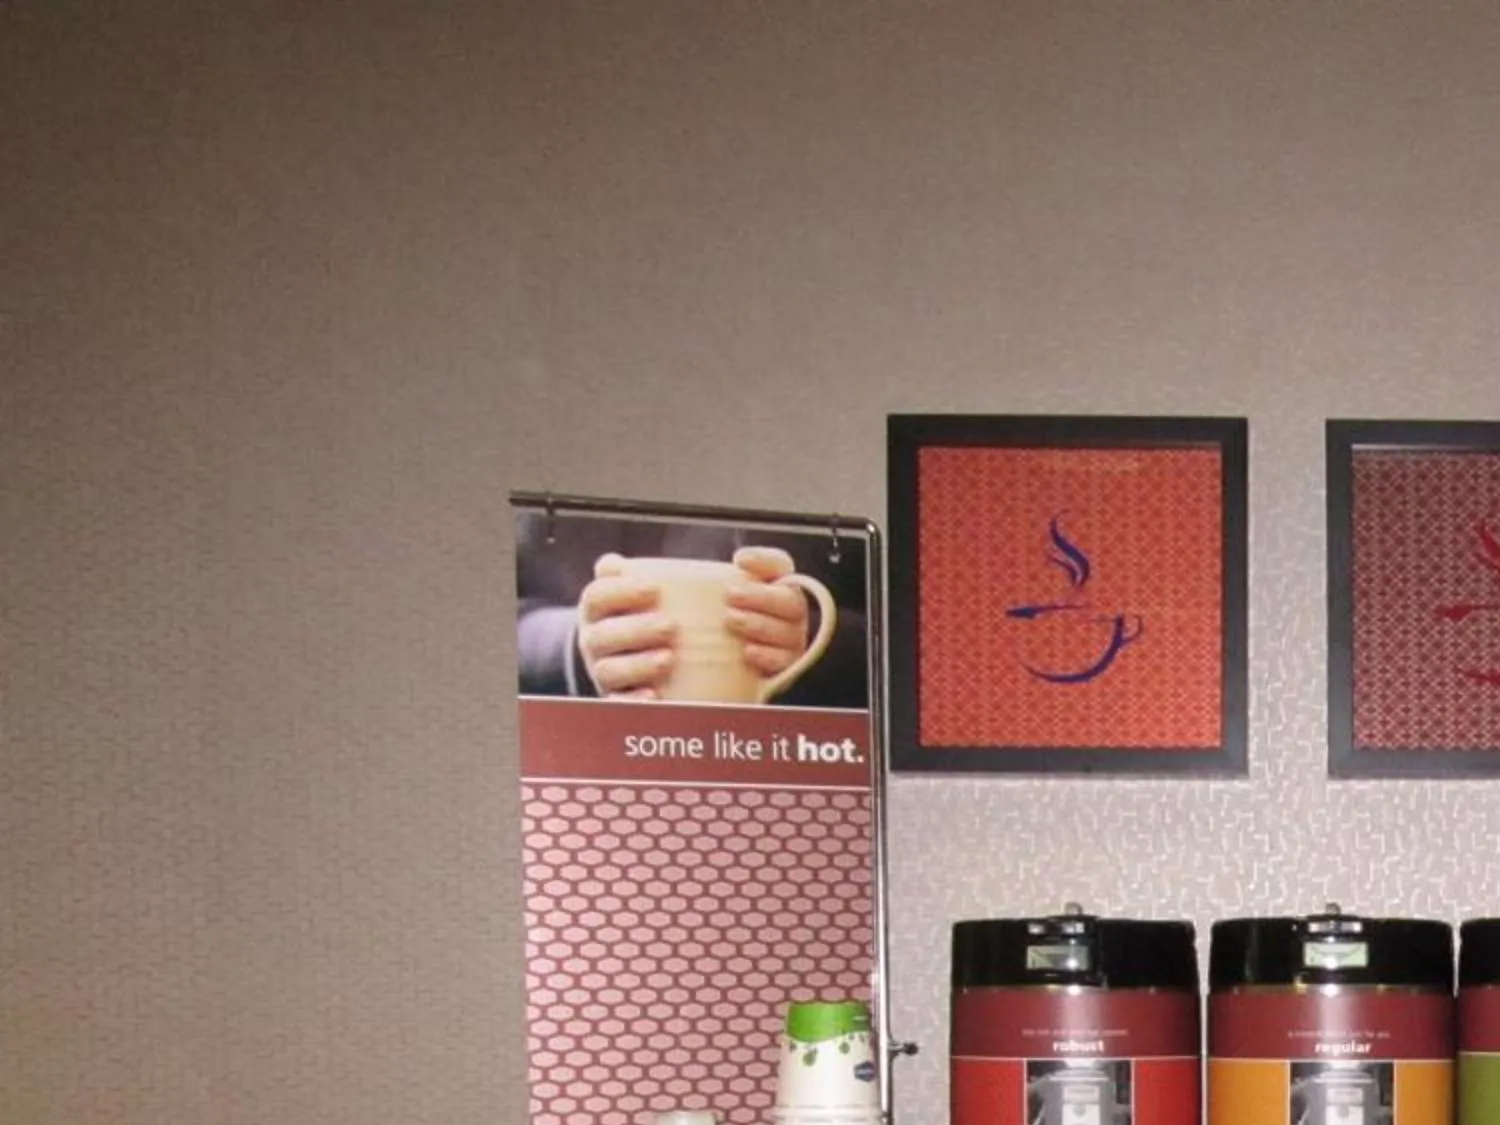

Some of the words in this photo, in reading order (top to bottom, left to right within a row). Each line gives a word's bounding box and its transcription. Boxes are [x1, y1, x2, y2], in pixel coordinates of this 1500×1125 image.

[624, 734, 704, 759] some
[713, 731, 763, 761] like
[772, 733, 790, 761] it
[797, 733, 865, 763] hot.
[1315, 1040, 1371, 1056] regular
